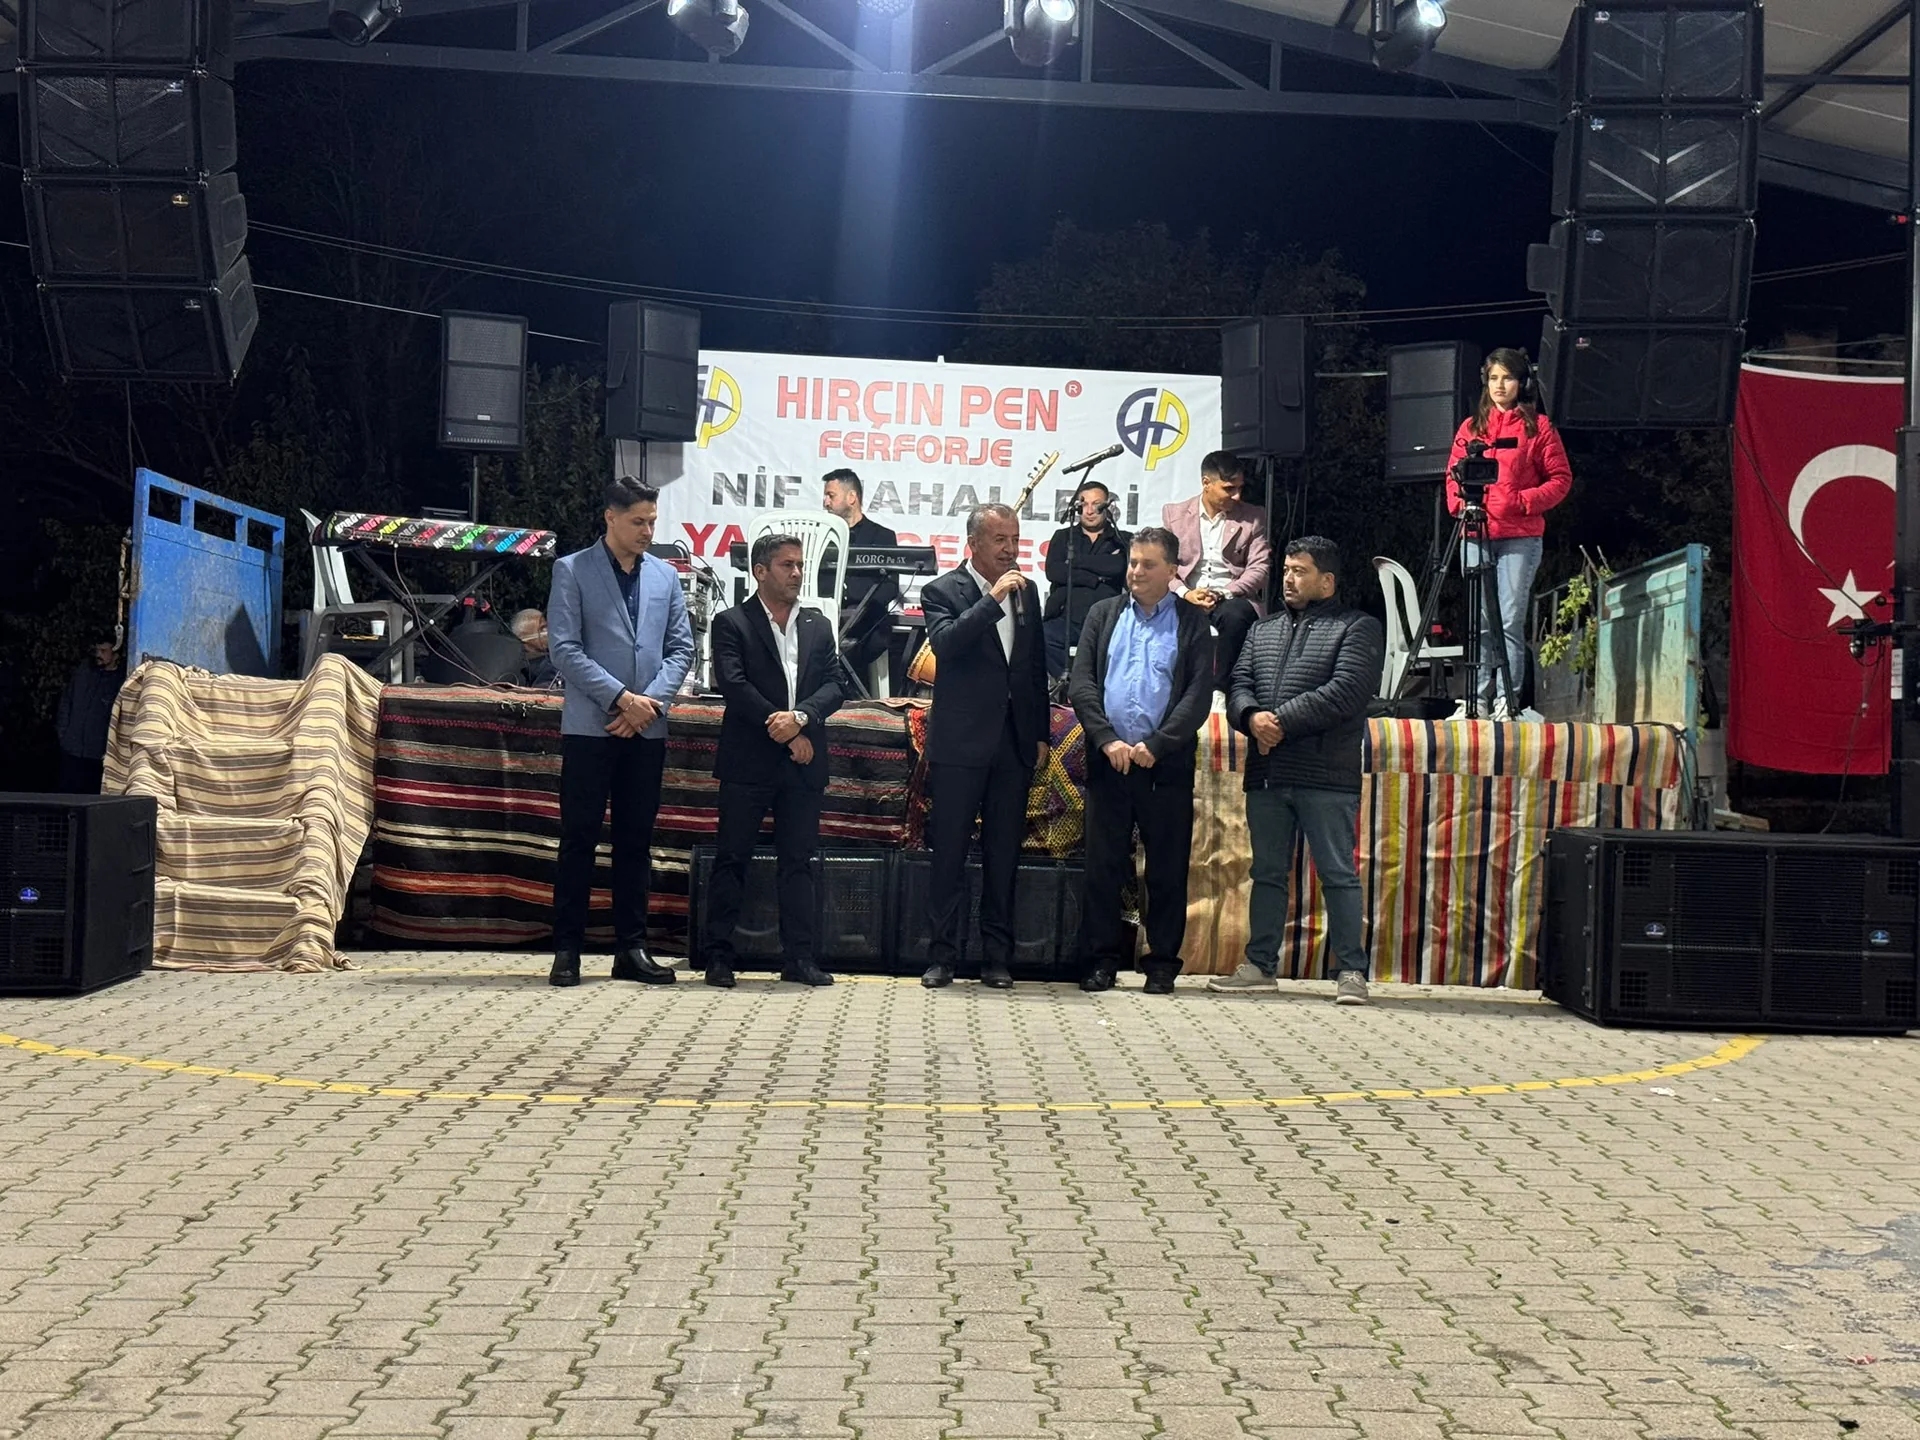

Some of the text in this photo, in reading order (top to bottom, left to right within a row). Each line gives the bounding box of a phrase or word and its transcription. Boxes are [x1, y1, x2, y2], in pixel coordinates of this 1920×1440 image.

[776, 375, 944, 430] HIRÇIN
[959, 384, 1060, 432] PEN
[818, 429, 1013, 468] FERFORJE
[711, 465, 803, 509] NİF
[855, 554, 885, 564] KORG
